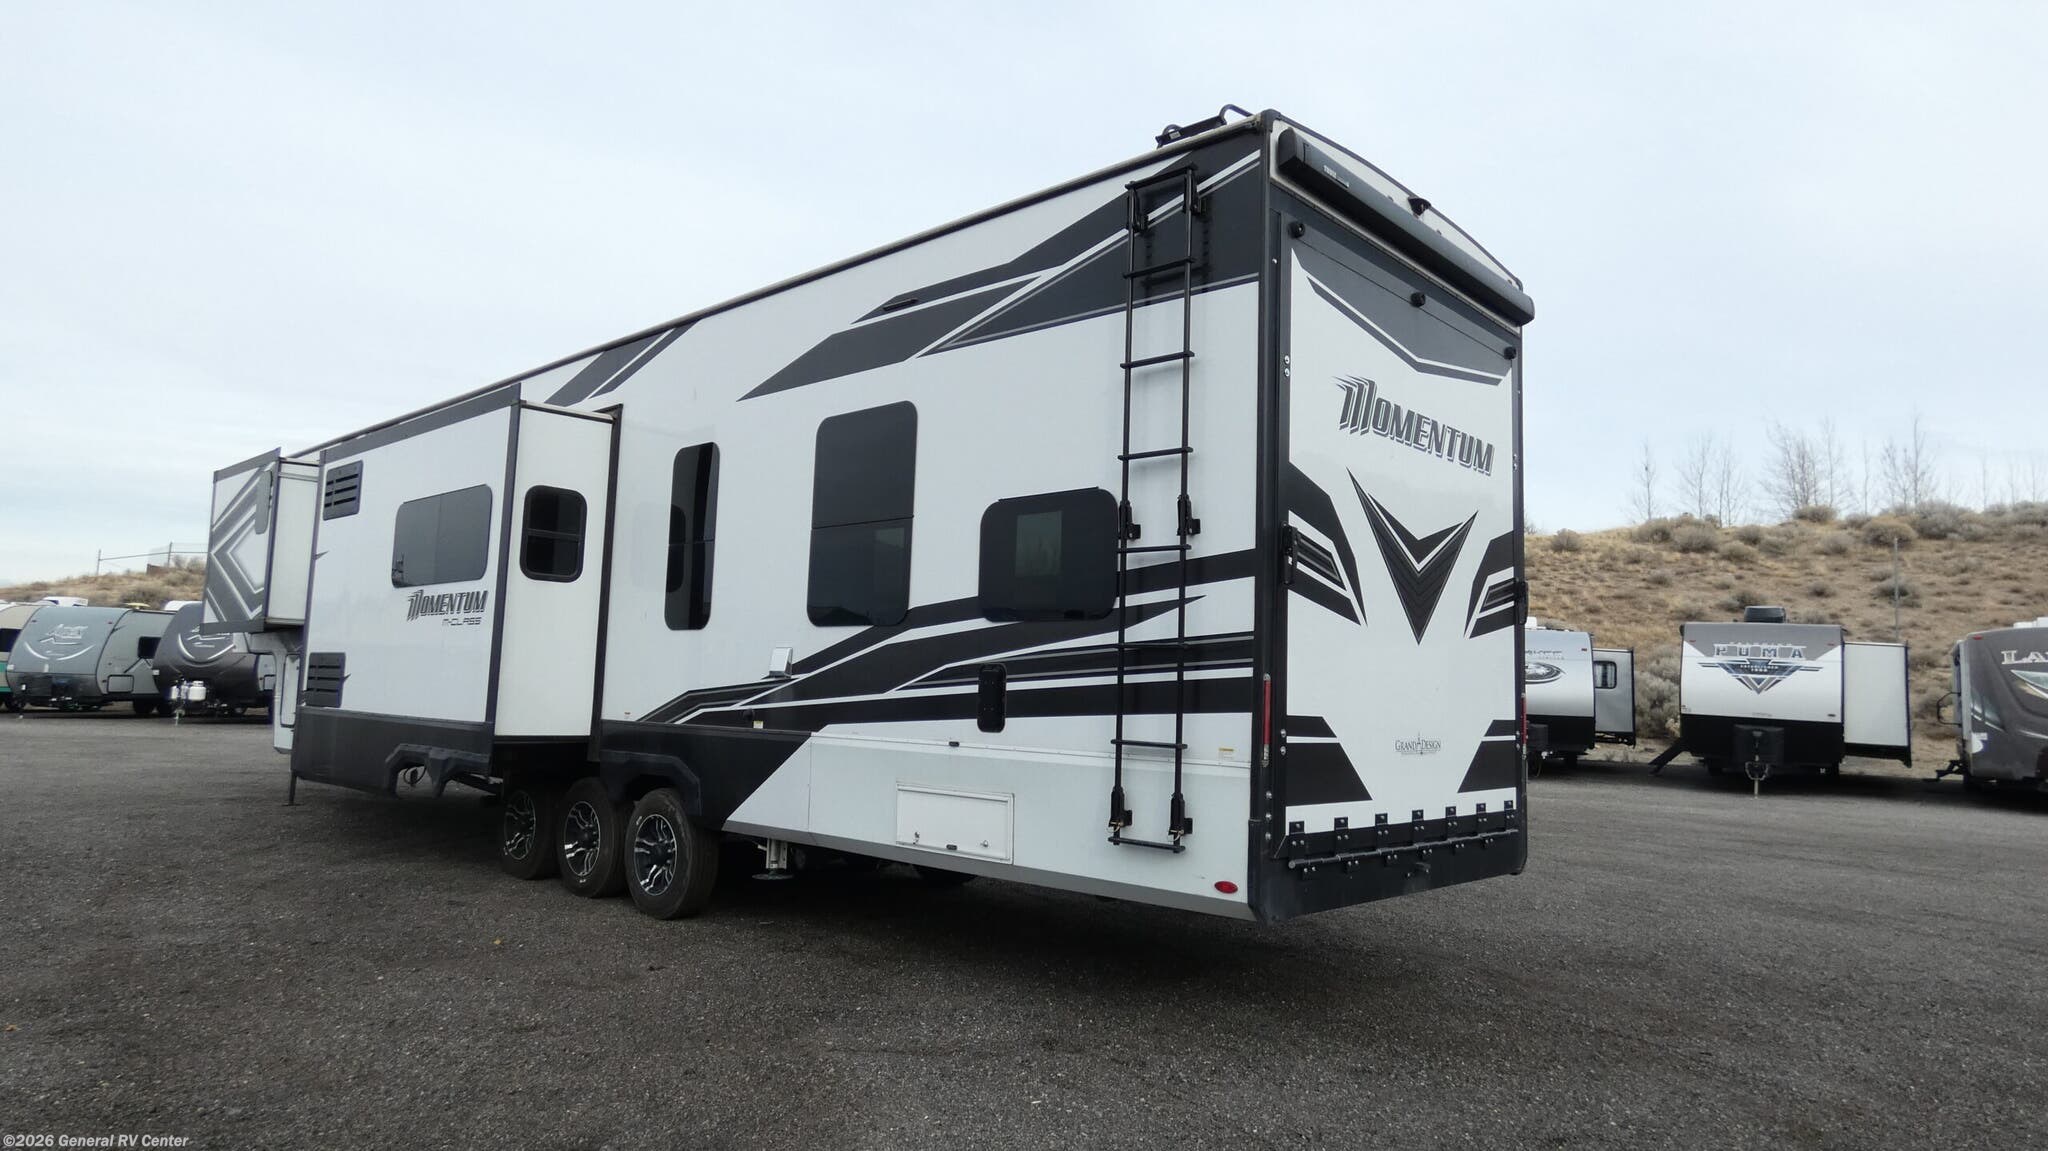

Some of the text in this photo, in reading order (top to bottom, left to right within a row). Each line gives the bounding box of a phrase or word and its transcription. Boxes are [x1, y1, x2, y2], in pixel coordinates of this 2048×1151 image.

[1332, 374, 1495, 476] MOMENTUM
[406, 589, 488, 621] MOMENTUM
[1713, 643, 1807, 661] PUMA
